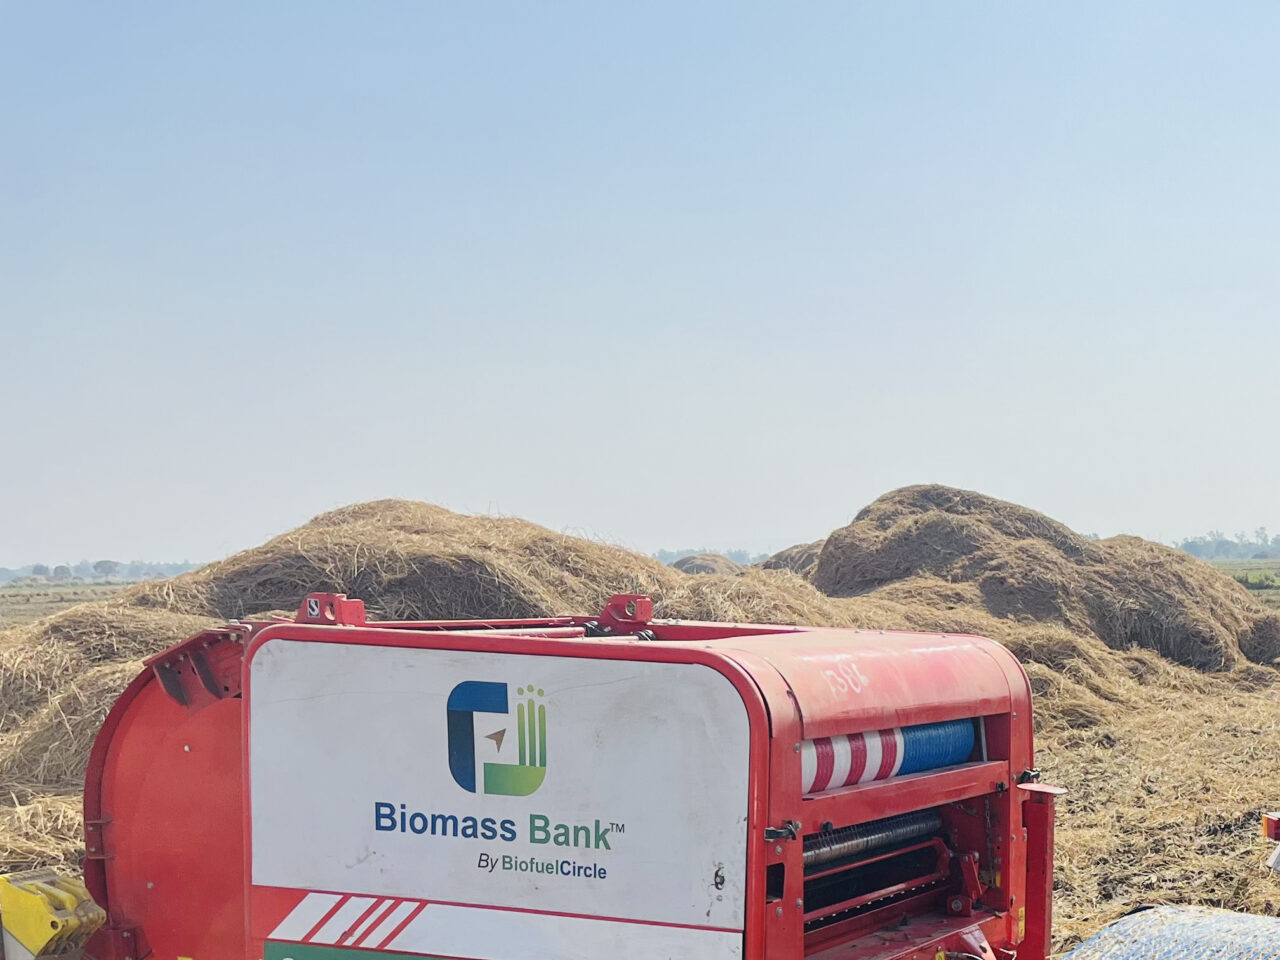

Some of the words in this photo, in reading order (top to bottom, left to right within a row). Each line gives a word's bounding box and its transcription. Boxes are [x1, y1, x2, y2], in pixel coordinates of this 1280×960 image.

[374, 801, 517, 842] Biomass
[477, 852, 499, 873] By
[501, 854, 608, 880] BiofuelCircle
